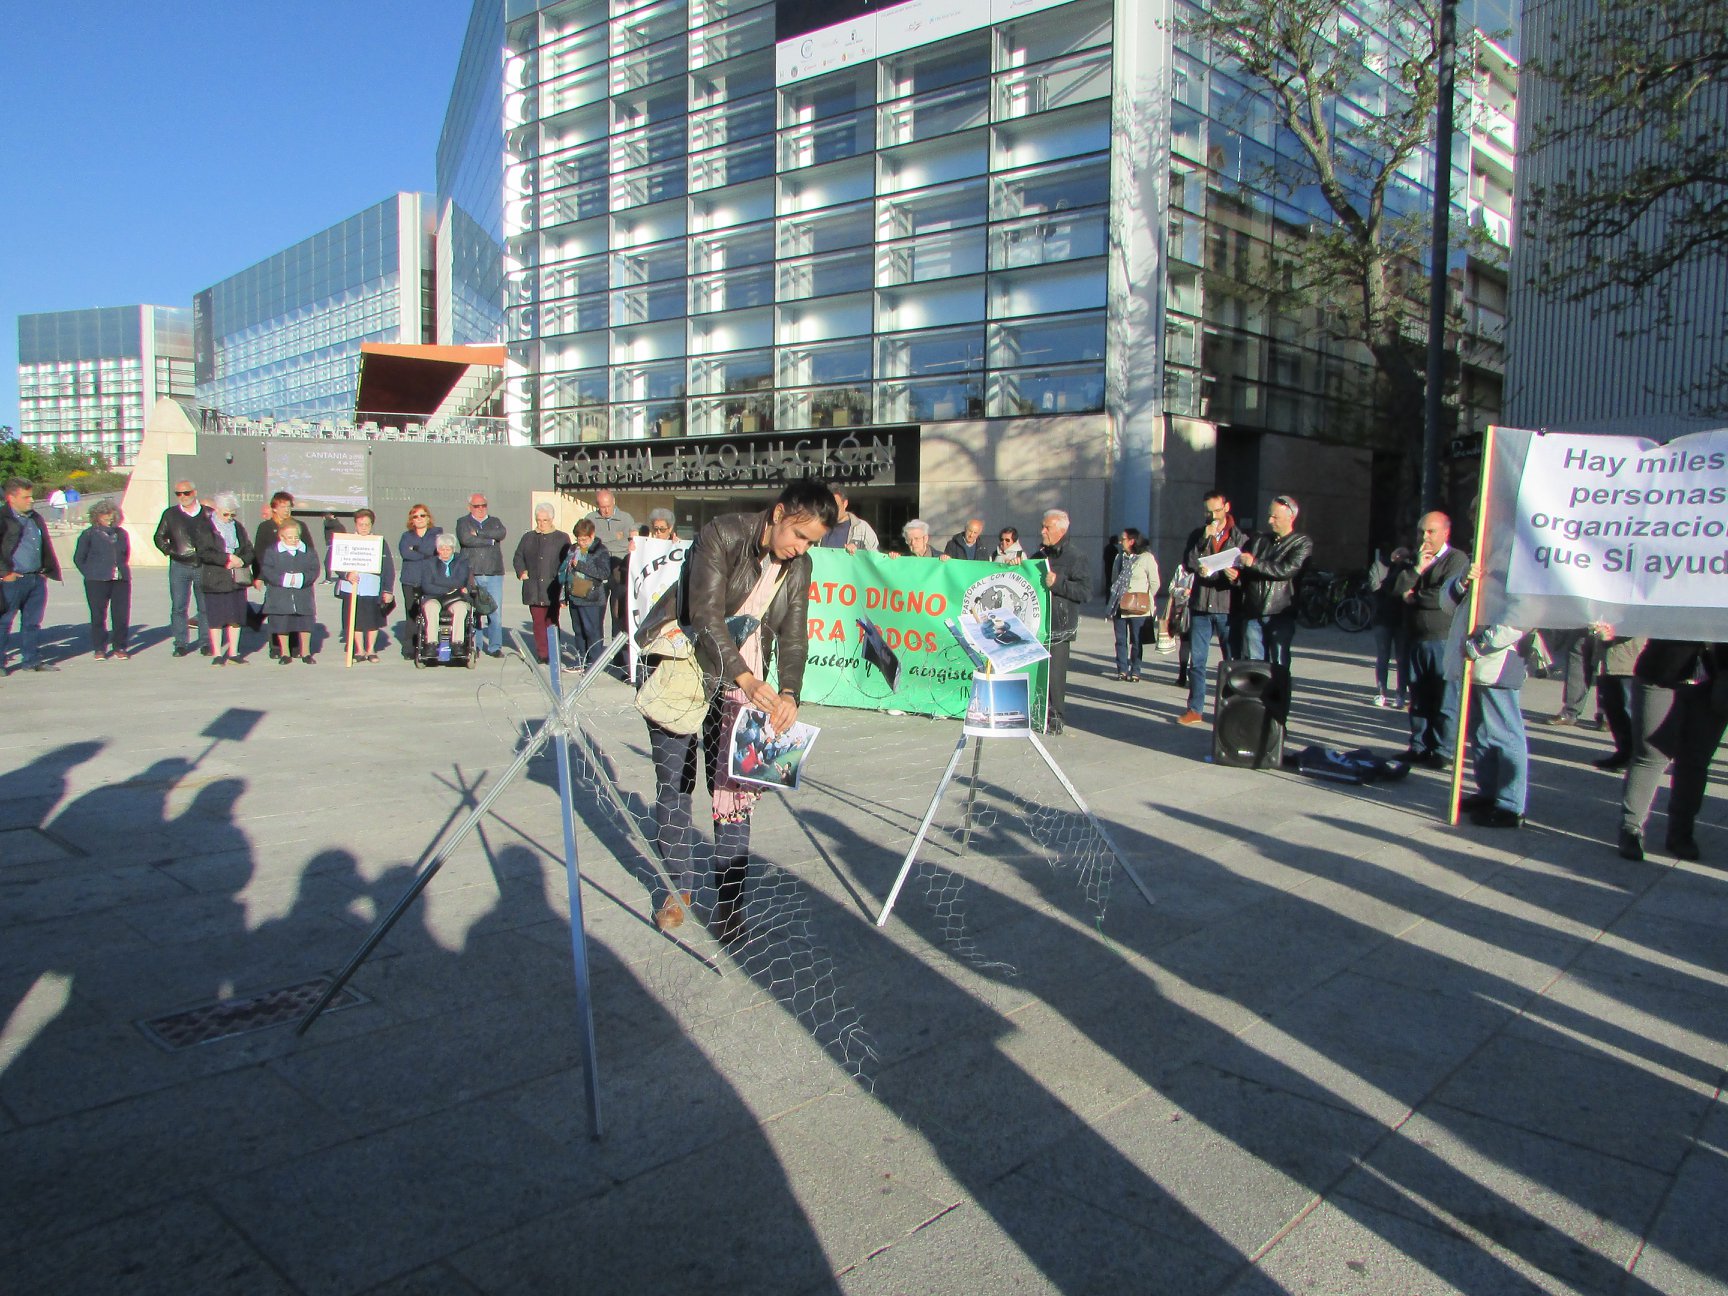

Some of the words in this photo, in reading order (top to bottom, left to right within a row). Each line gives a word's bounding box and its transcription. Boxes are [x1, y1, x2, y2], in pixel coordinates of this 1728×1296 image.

[558, 446, 654, 473] FÓRUM
[674, 431, 894, 471] EVOLUCIÓN
[1563, 448, 1627, 478] Hay
[1636, 451, 1726, 473] miles
[1569, 487, 1728, 508] personas
[1531, 512, 1728, 540] organizacio
[1534, 545, 1592, 569] que
[1602, 543, 1635, 573] SÍ
[1644, 550, 1728, 579] ayud
[808, 581, 857, 606] ATO
[865, 587, 947, 616] DIGNO
[962, 579, 988, 615] PASTORAL
[990, 573, 1006, 581] CON
[1008, 572, 1041, 619] INMIGRANTES
[807, 618, 846, 642] RA
[807, 654, 860, 669] astero
